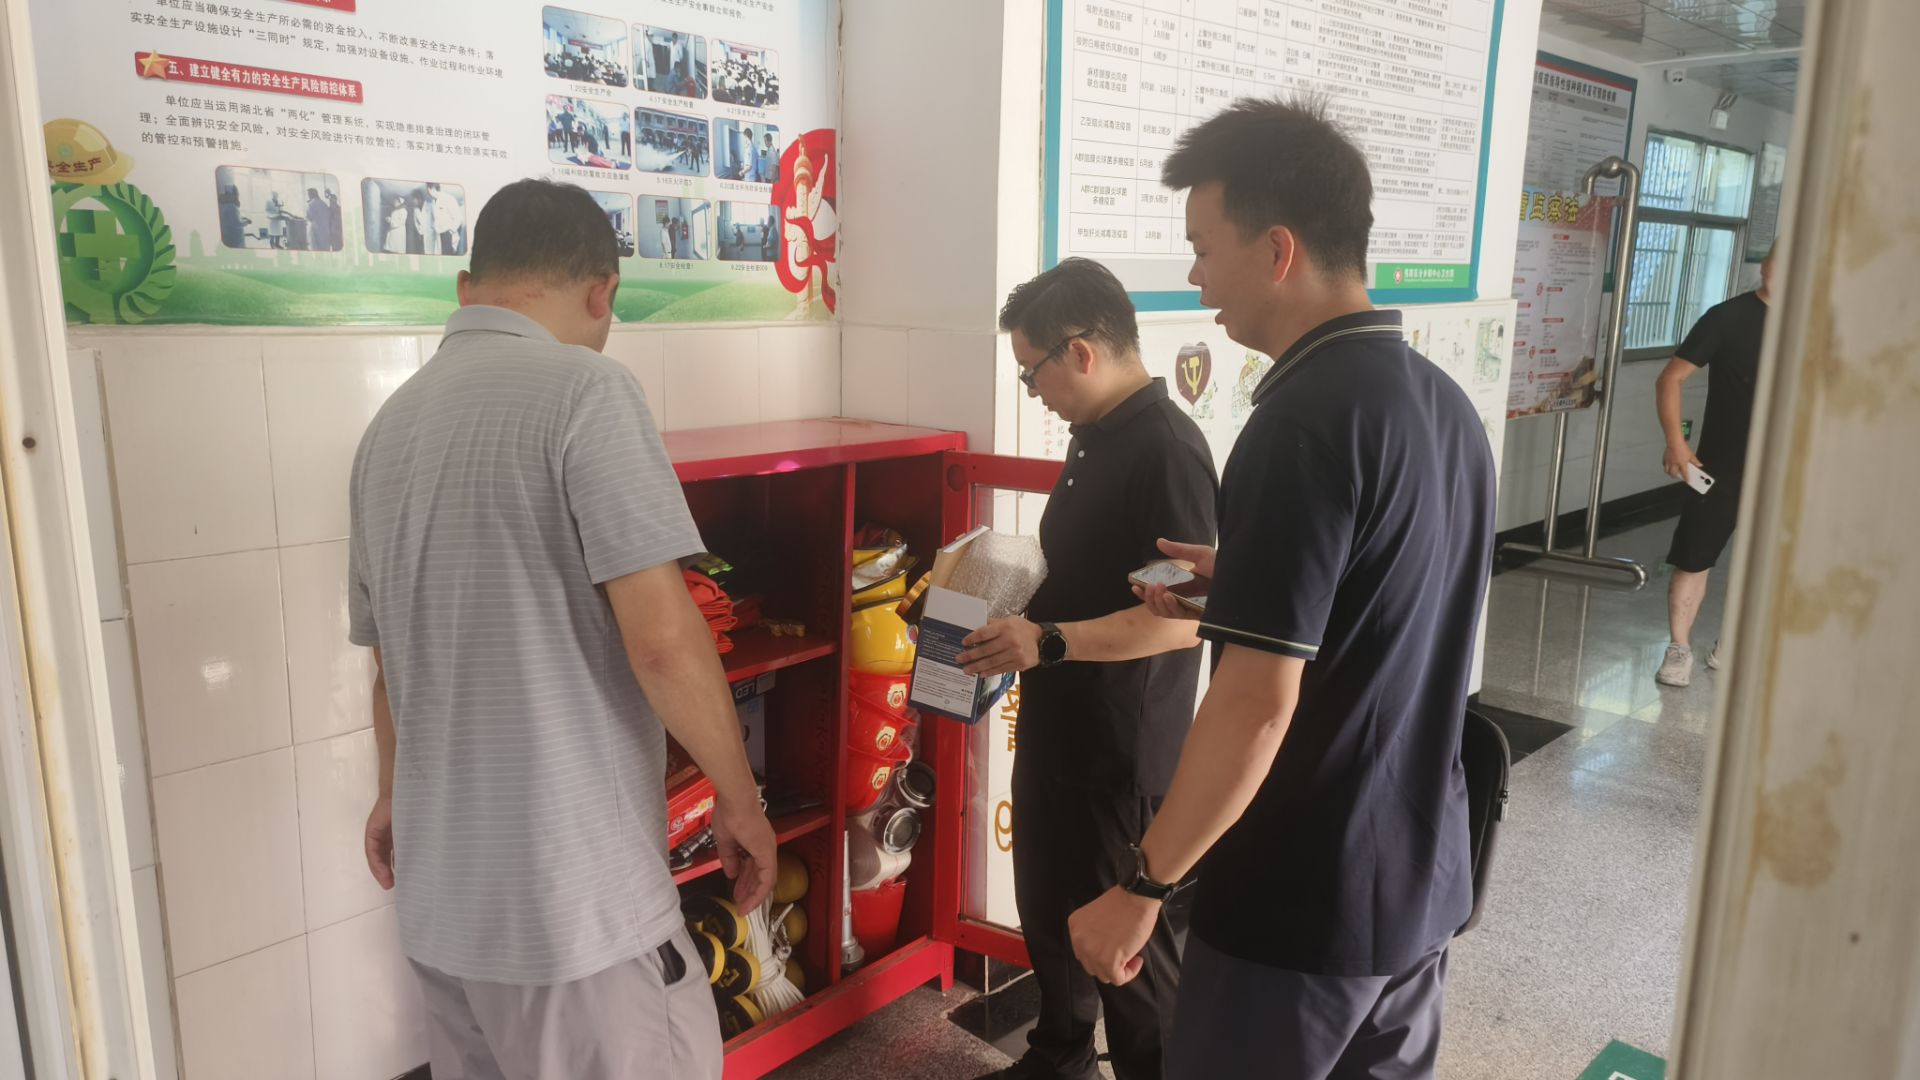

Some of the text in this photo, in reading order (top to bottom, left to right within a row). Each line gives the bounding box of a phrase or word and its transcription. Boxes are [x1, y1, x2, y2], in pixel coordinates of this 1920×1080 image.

[168, 61, 358, 98] 五、建立健全有力的安全生产风险防控体系
[141, 132, 249, 152] 的管控和预警措施。
